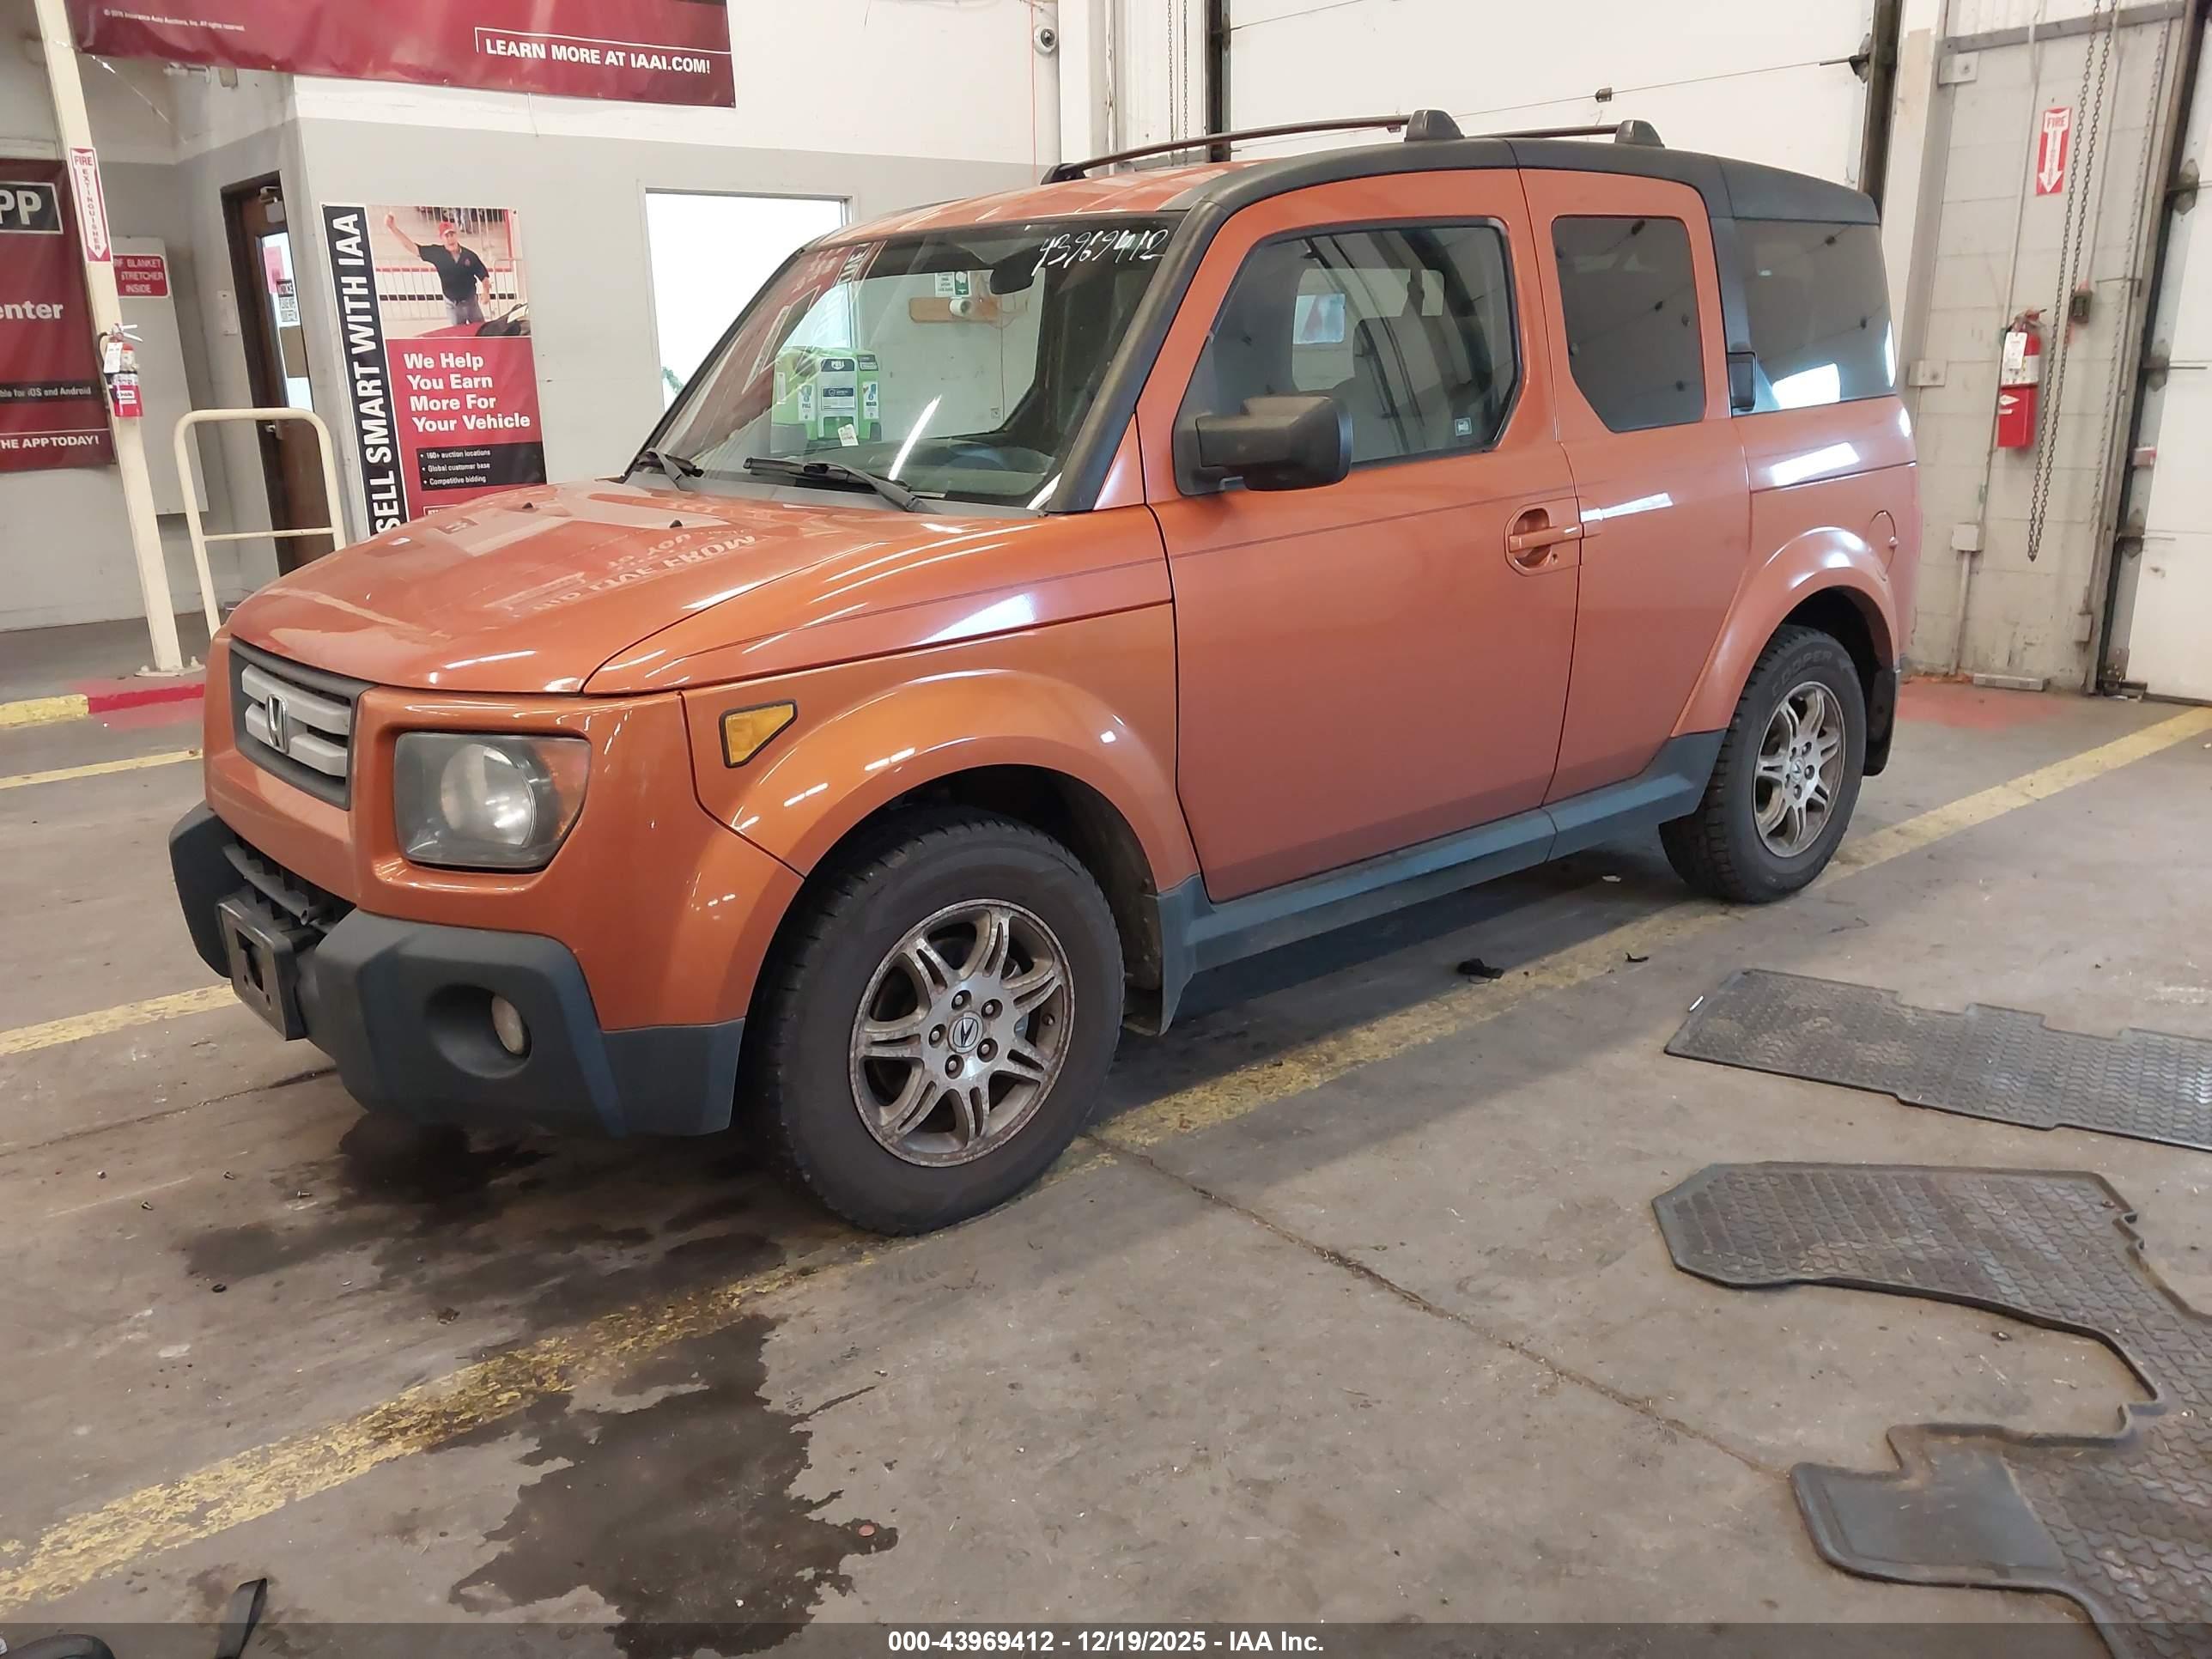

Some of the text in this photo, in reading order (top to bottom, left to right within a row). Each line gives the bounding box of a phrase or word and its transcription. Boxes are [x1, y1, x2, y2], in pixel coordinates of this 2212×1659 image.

[485, 38, 710, 75] LEARN MORE AT IAAI.COM!
[74, 155, 94, 166] FIRE
[126, 258, 161, 268] BLANKET
[125, 284, 151, 294] INSIDE
[404, 352, 484, 371] We Help
[332, 213, 401, 533] SELL SMART WITH IAA
[406, 374, 493, 390] You Earn
[60, 386, 91, 395] Android
[410, 394, 496, 411] More For
[412, 413, 531, 433] Your Vehicle
[22, 438, 49, 448] APP
[50, 435, 100, 447] TODAY!
[441, 450, 464, 459] auction
[428, 464, 447, 472] Global
[429, 475, 487, 485] Competitive bidding
